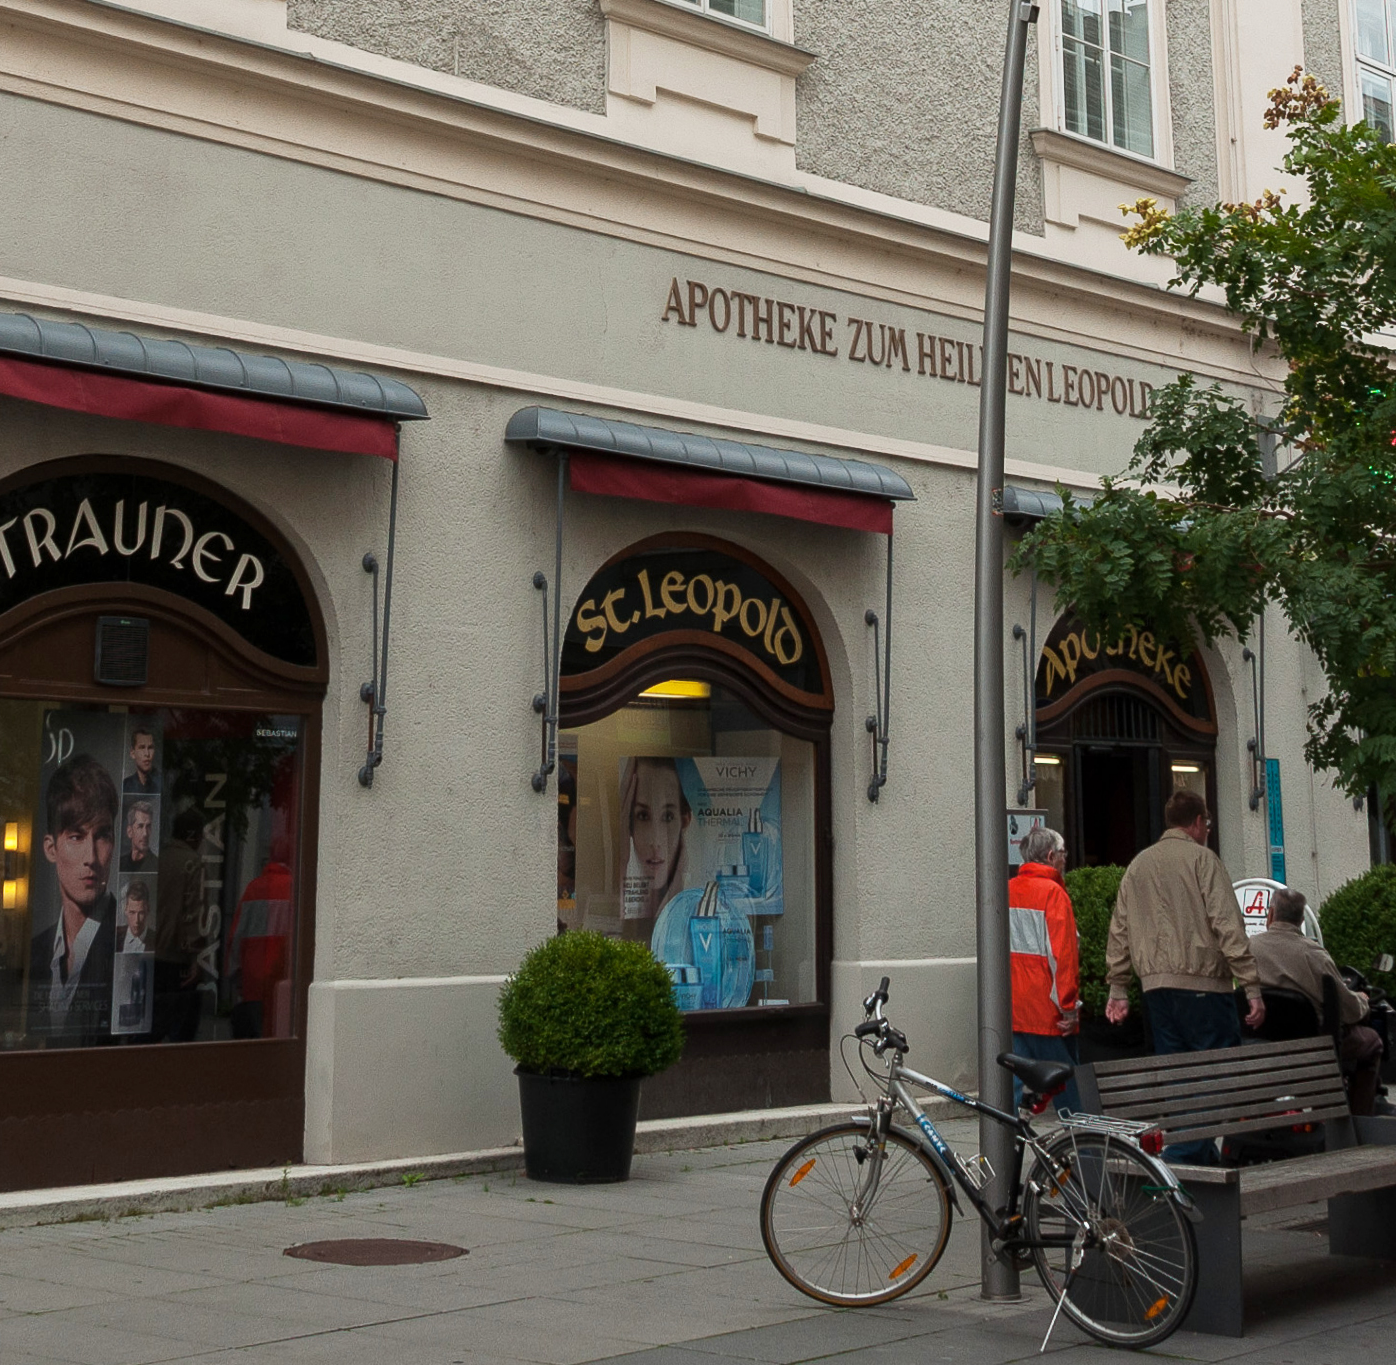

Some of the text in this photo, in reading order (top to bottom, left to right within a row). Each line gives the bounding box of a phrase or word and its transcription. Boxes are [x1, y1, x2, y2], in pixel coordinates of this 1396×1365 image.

[660, 276, 1156, 421] APOTHEKE ZUM HEILEN LEOPOLD
[1041, 623, 1192, 700] Apoheke
[255, 727, 298, 739] SEBASTIAN
[715, 765, 758, 778] VICHY
[697, 807, 744, 818] AQUALIA
